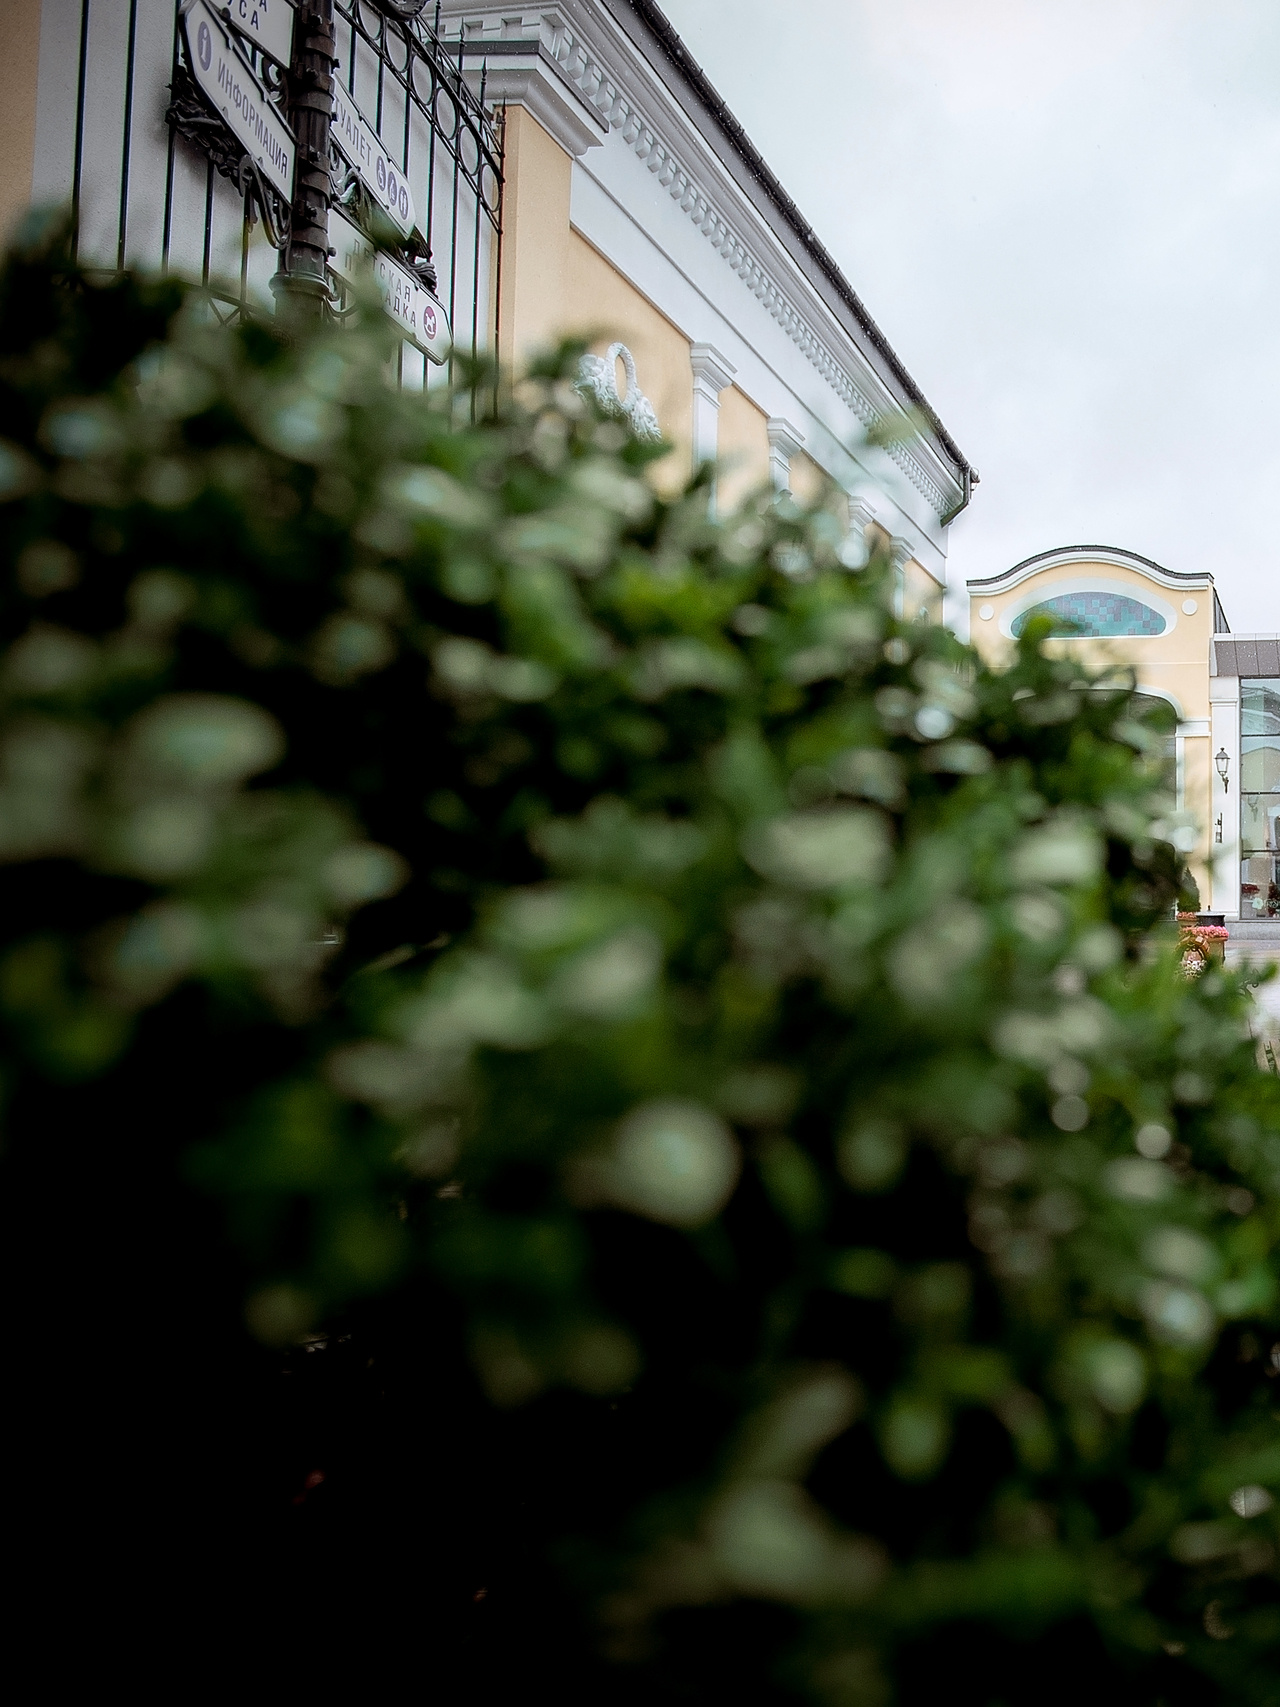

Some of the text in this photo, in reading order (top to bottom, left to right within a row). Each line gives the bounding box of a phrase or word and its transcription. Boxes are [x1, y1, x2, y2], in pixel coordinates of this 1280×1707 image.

[217, 57, 288, 179] ИНФОРМАЦИЯ
[333, 94, 372, 167] ТУАЛЕТ
[344, 251, 417, 328] ПАДКА
